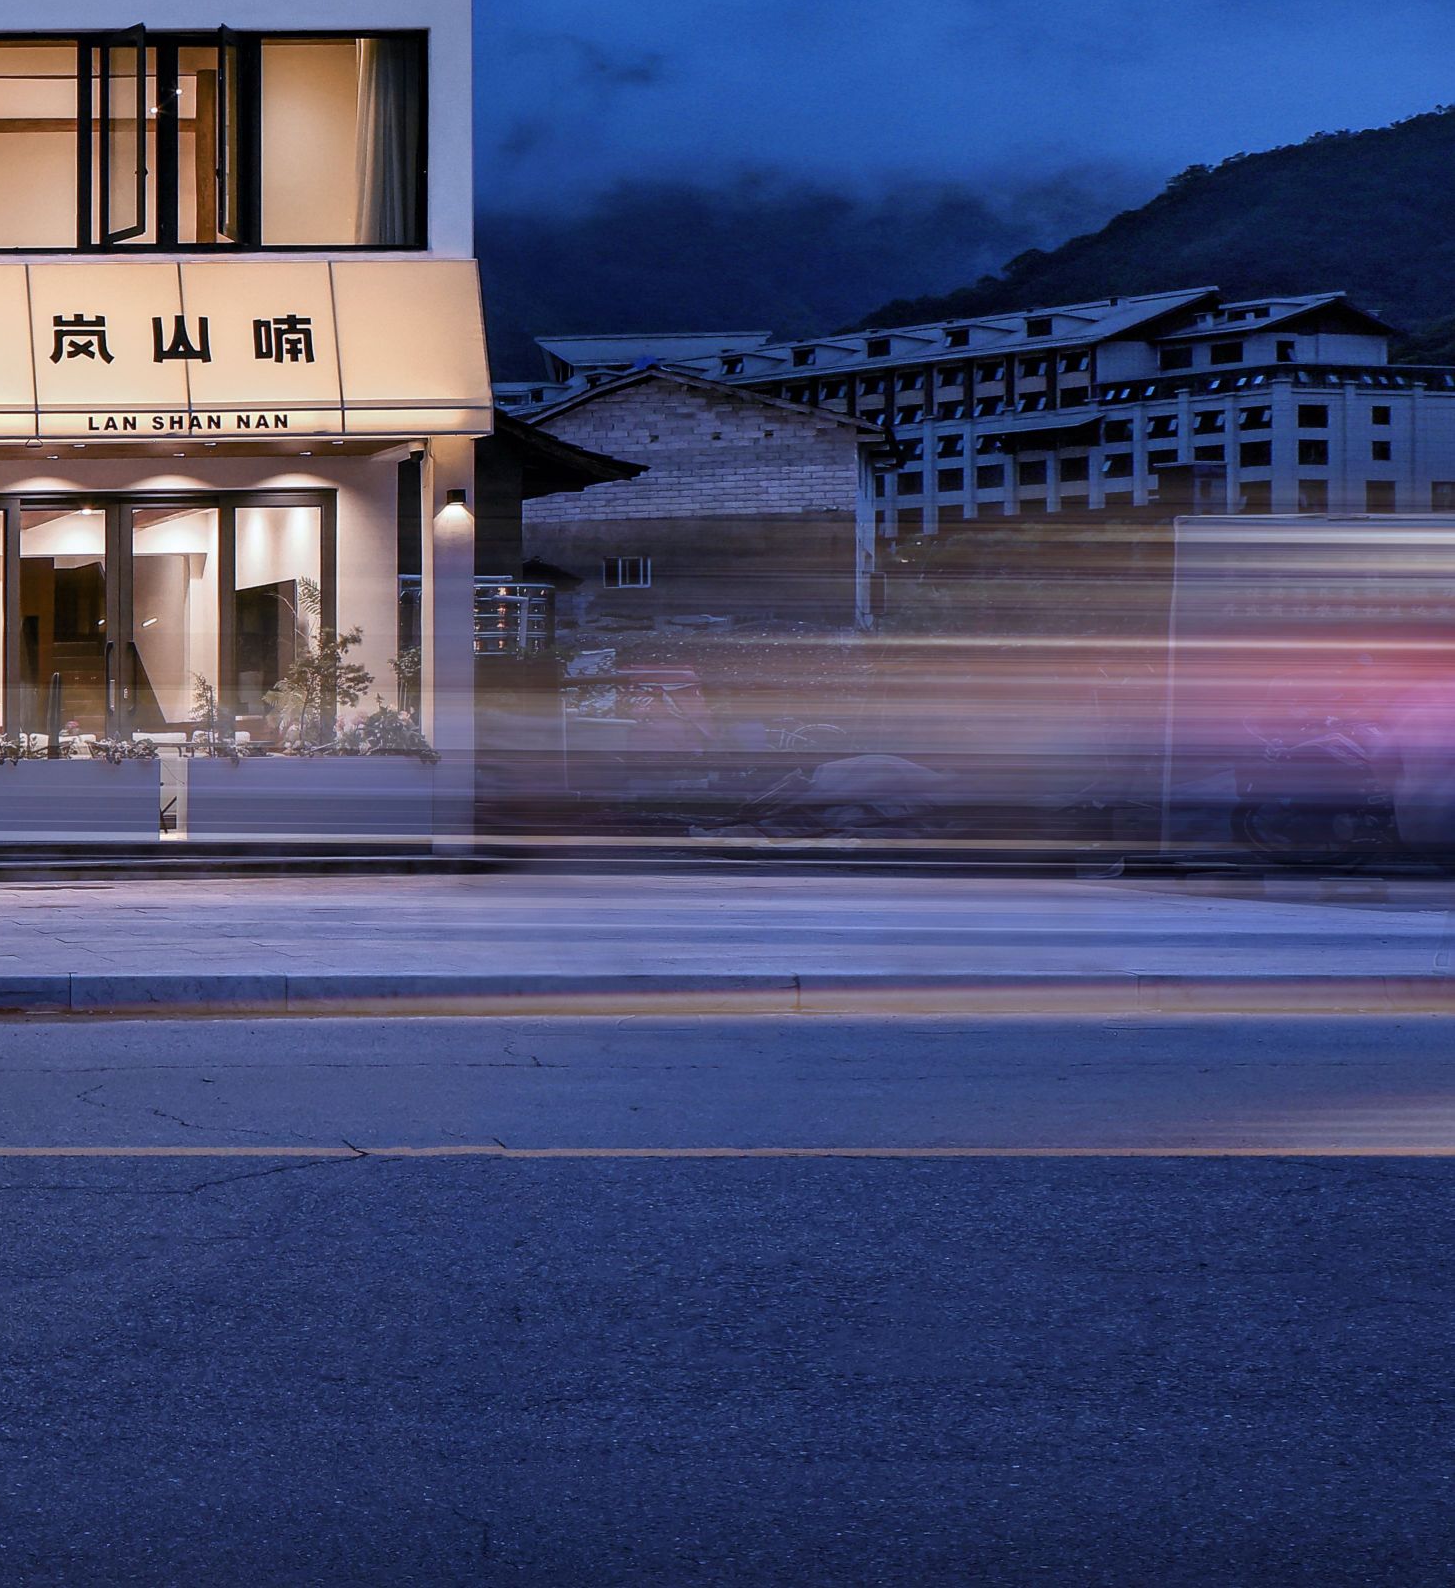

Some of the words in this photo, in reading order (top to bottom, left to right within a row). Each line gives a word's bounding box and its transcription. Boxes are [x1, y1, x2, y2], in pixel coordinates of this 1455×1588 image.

[49, 313, 316, 367] 岚山喃
[88, 416, 138, 431] LAN
[152, 414, 221, 431] SHAN
[236, 414, 290, 430] NAN
